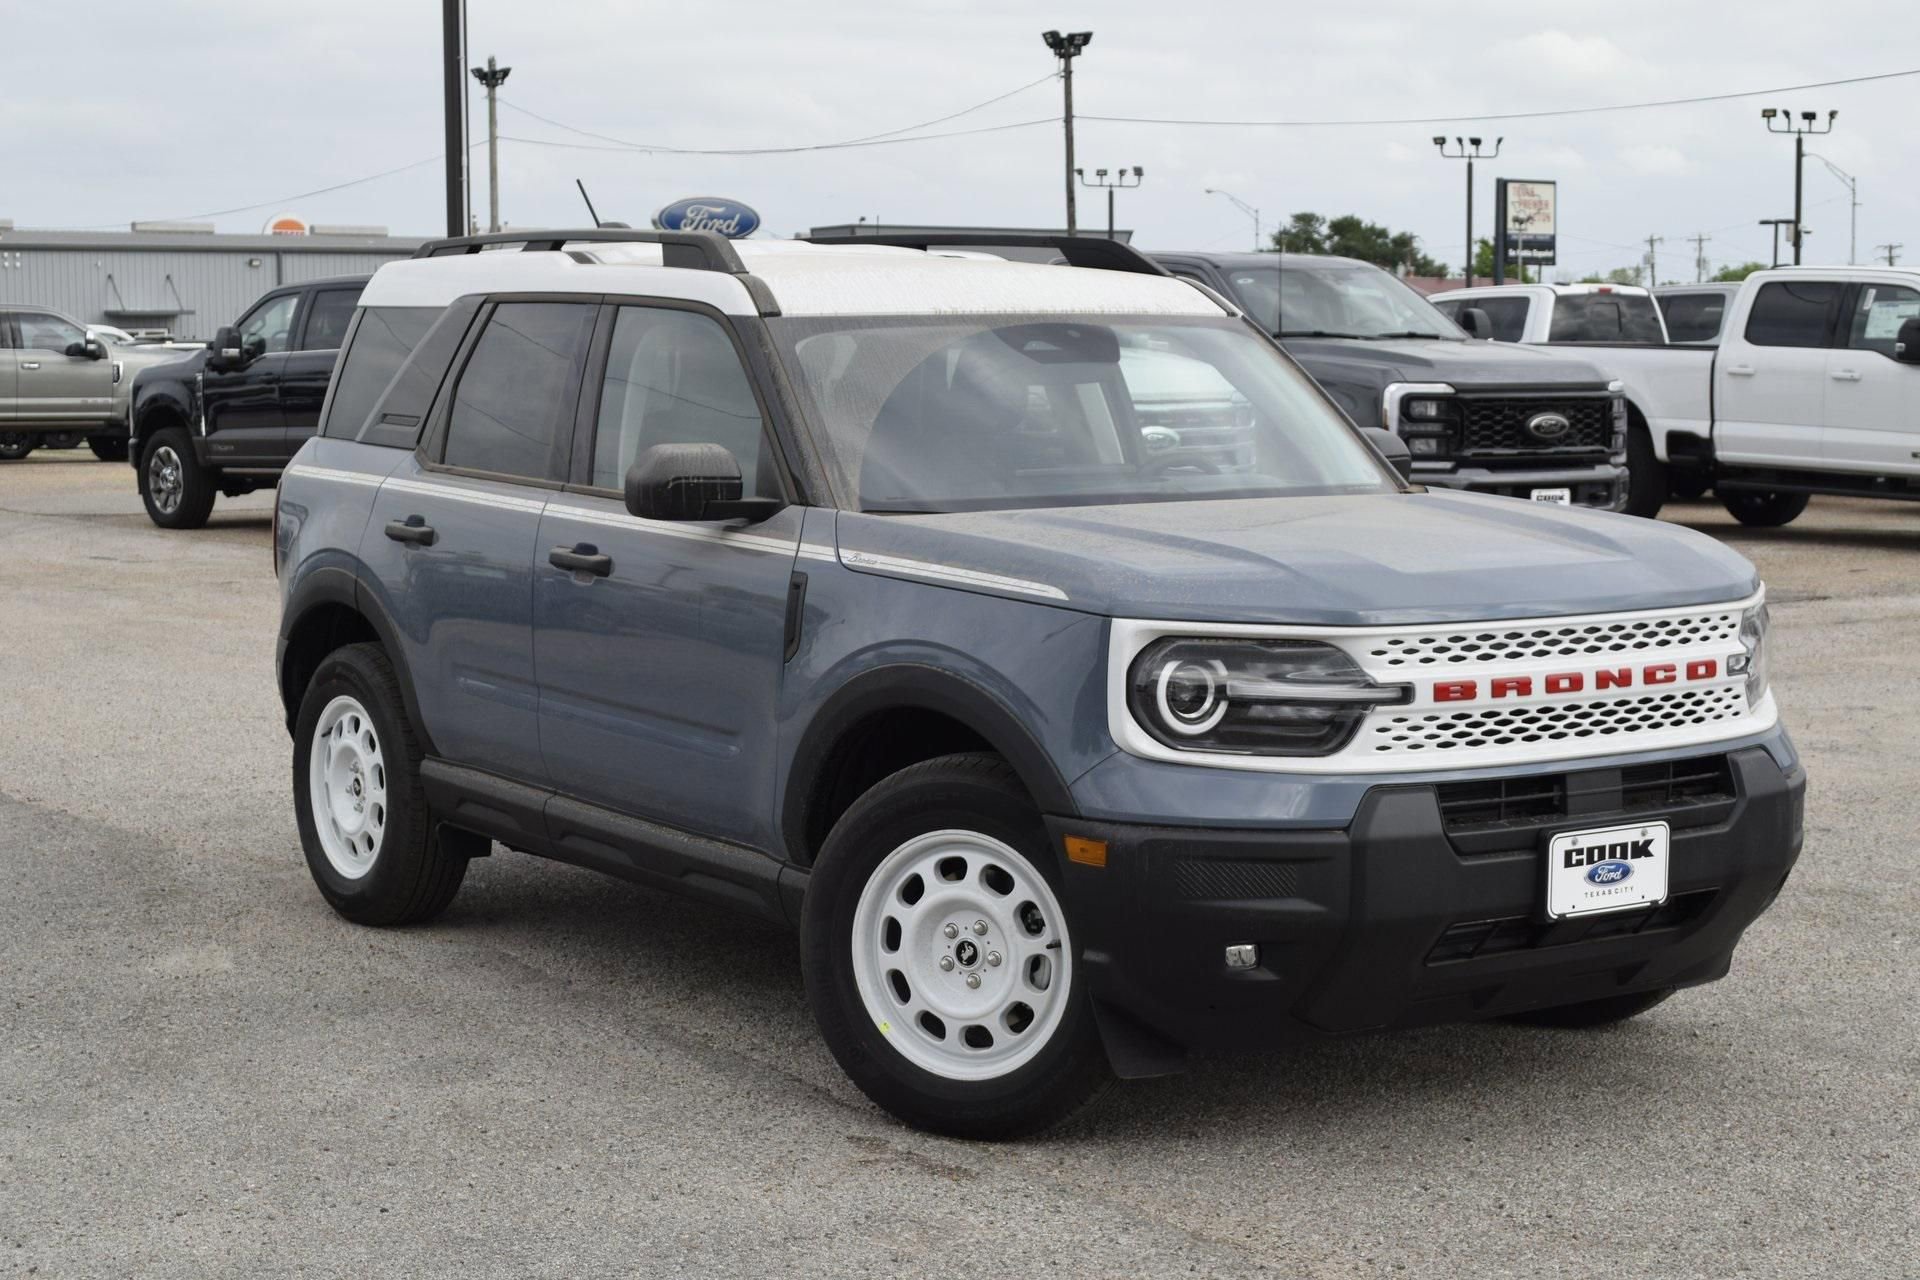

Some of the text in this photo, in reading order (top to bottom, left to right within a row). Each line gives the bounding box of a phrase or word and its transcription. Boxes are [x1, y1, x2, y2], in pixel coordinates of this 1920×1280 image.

[681, 205, 740, 233] Ford
[1433, 659, 1717, 703] BRONCO
[1564, 838, 1655, 868] COOK
[1594, 865, 1622, 883] Ford
[1584, 886, 1634, 899] TEXAS CITY
